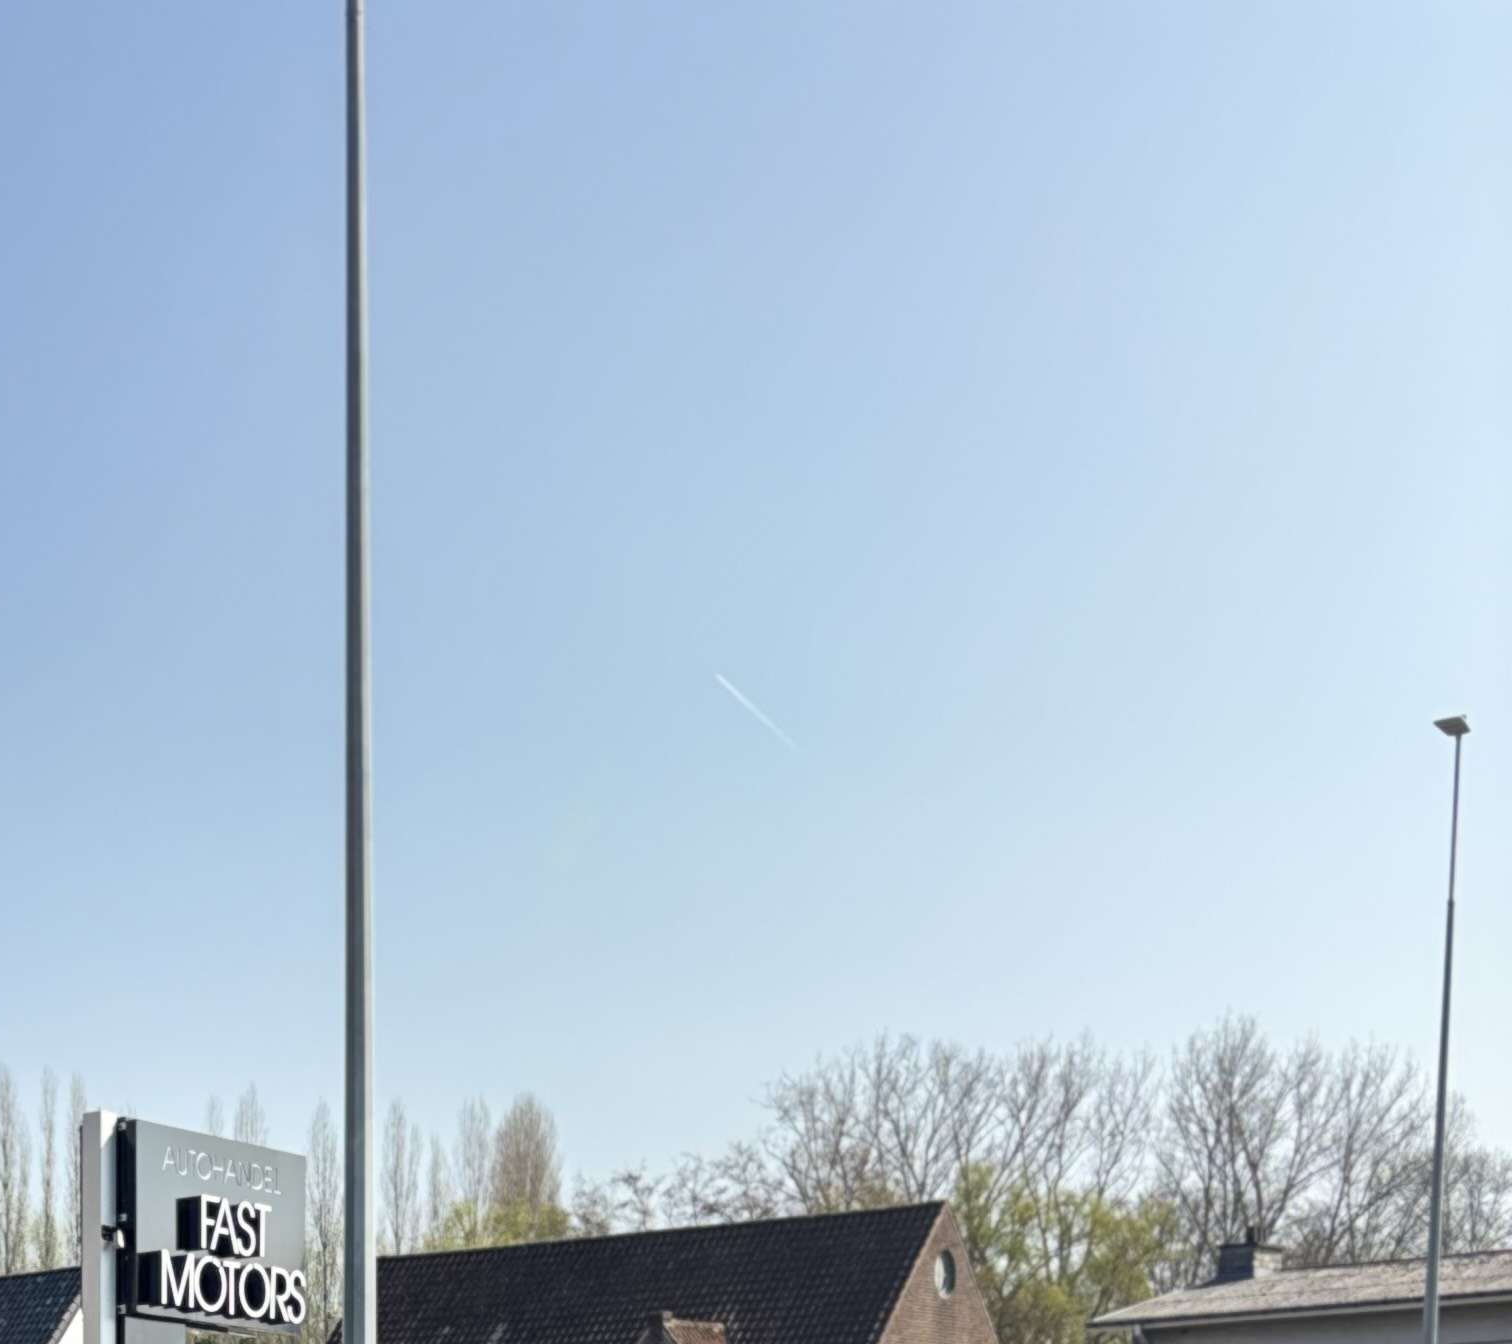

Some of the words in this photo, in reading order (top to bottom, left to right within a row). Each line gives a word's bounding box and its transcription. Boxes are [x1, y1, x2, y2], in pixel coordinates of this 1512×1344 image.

[162, 1146, 282, 1195] AUTOHANDEL
[200, 1193, 272, 1258] FAST
[160, 1248, 307, 1325] MOTORS
